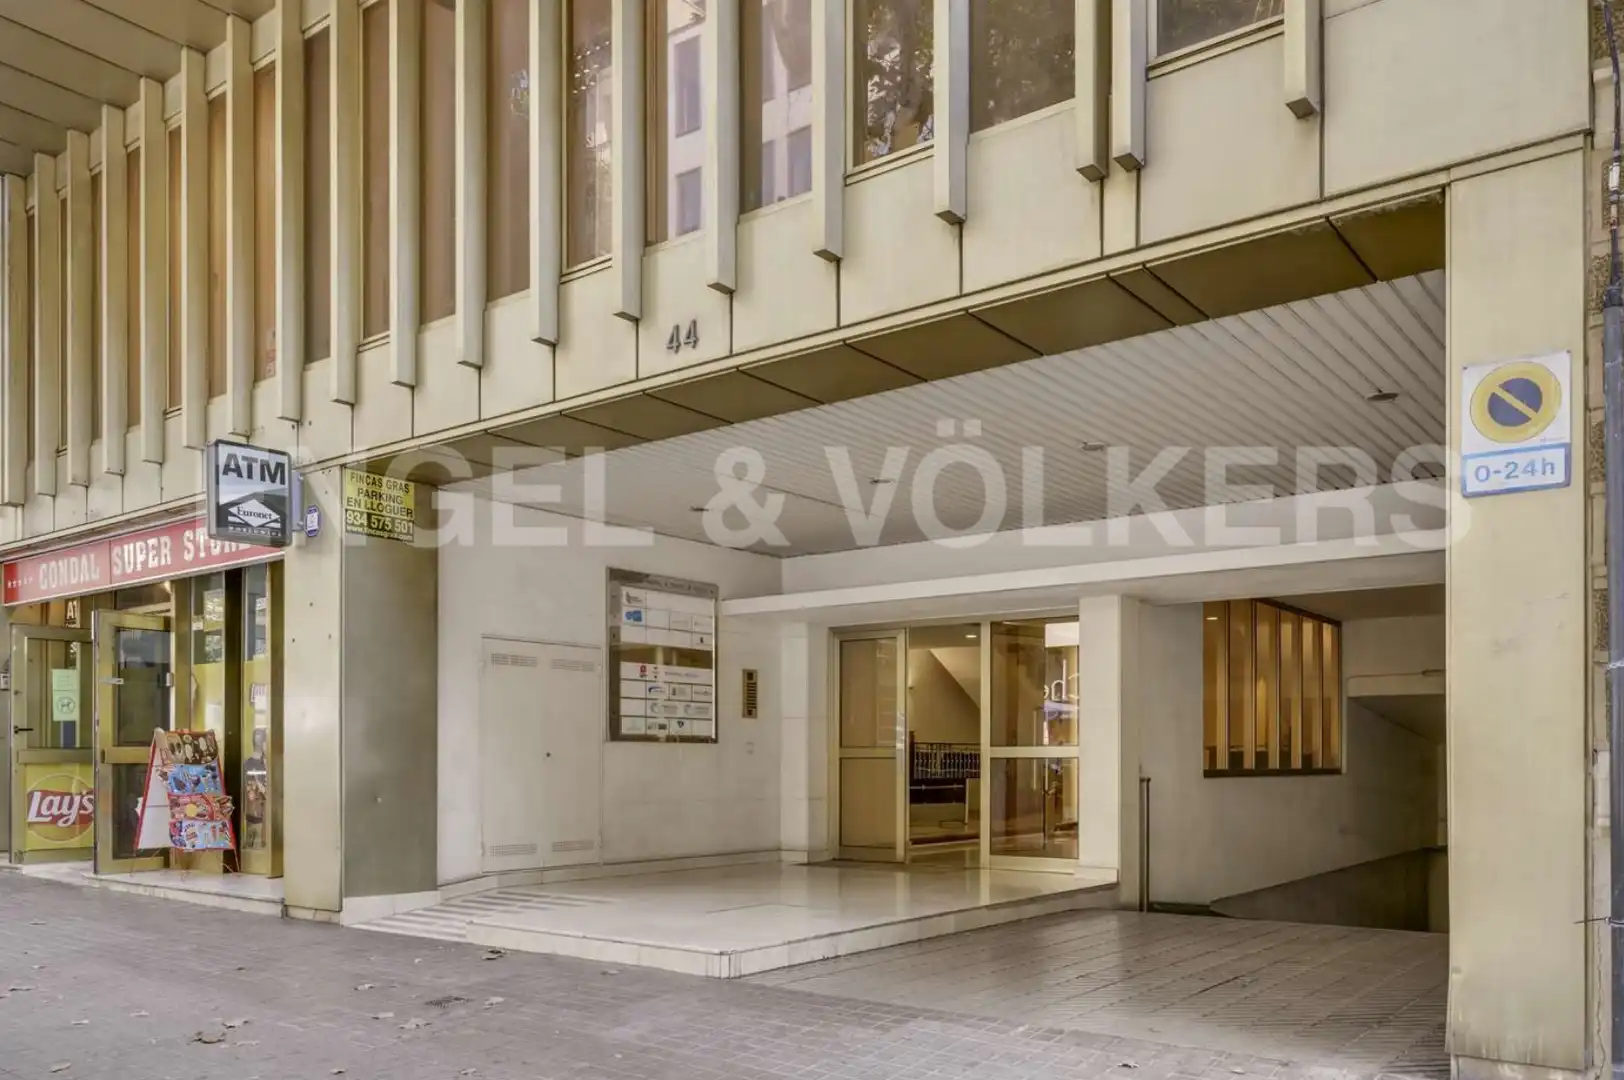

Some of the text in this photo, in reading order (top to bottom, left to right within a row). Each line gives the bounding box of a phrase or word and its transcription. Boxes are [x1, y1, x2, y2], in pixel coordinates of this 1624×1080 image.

[666, 319, 699, 354] 44
[222, 453, 286, 485] ATM
[1475, 458, 1555, 482] 0-24h
[350, 472, 410, 493] FINCAS GRAS
[346, 496, 413, 518] EN LLOGUER
[357, 487, 404, 505] PARKING
[237, 506, 273, 520] Euronet
[346, 510, 413, 534] 934 575 501
[39, 553, 100, 590] CONDAL
[112, 535, 171, 576] SUPER
